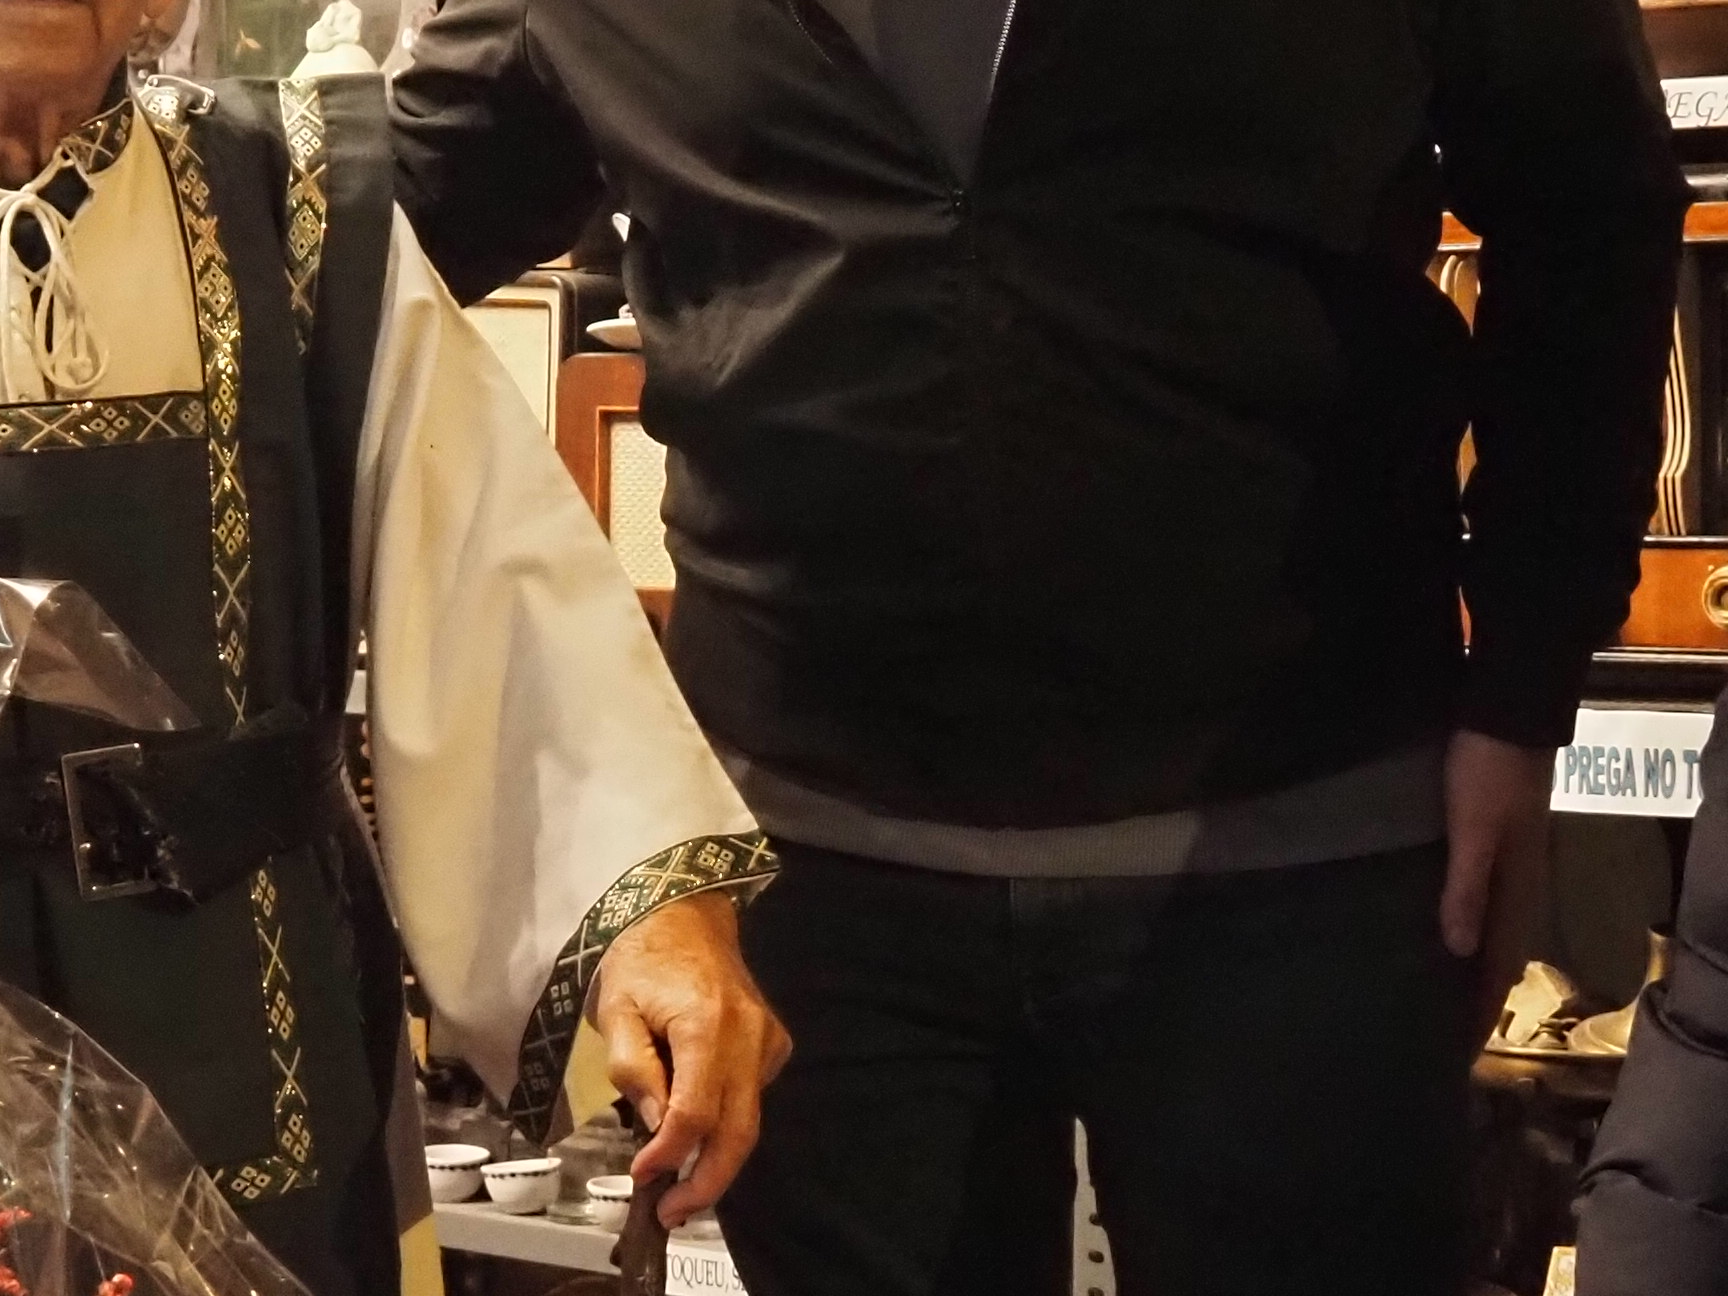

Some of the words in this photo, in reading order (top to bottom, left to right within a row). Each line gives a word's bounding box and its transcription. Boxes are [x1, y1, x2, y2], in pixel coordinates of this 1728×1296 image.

[1564, 744, 1637, 797] PREGA
[1643, 747, 1676, 799] NO
[1682, 749, 1704, 800] T
